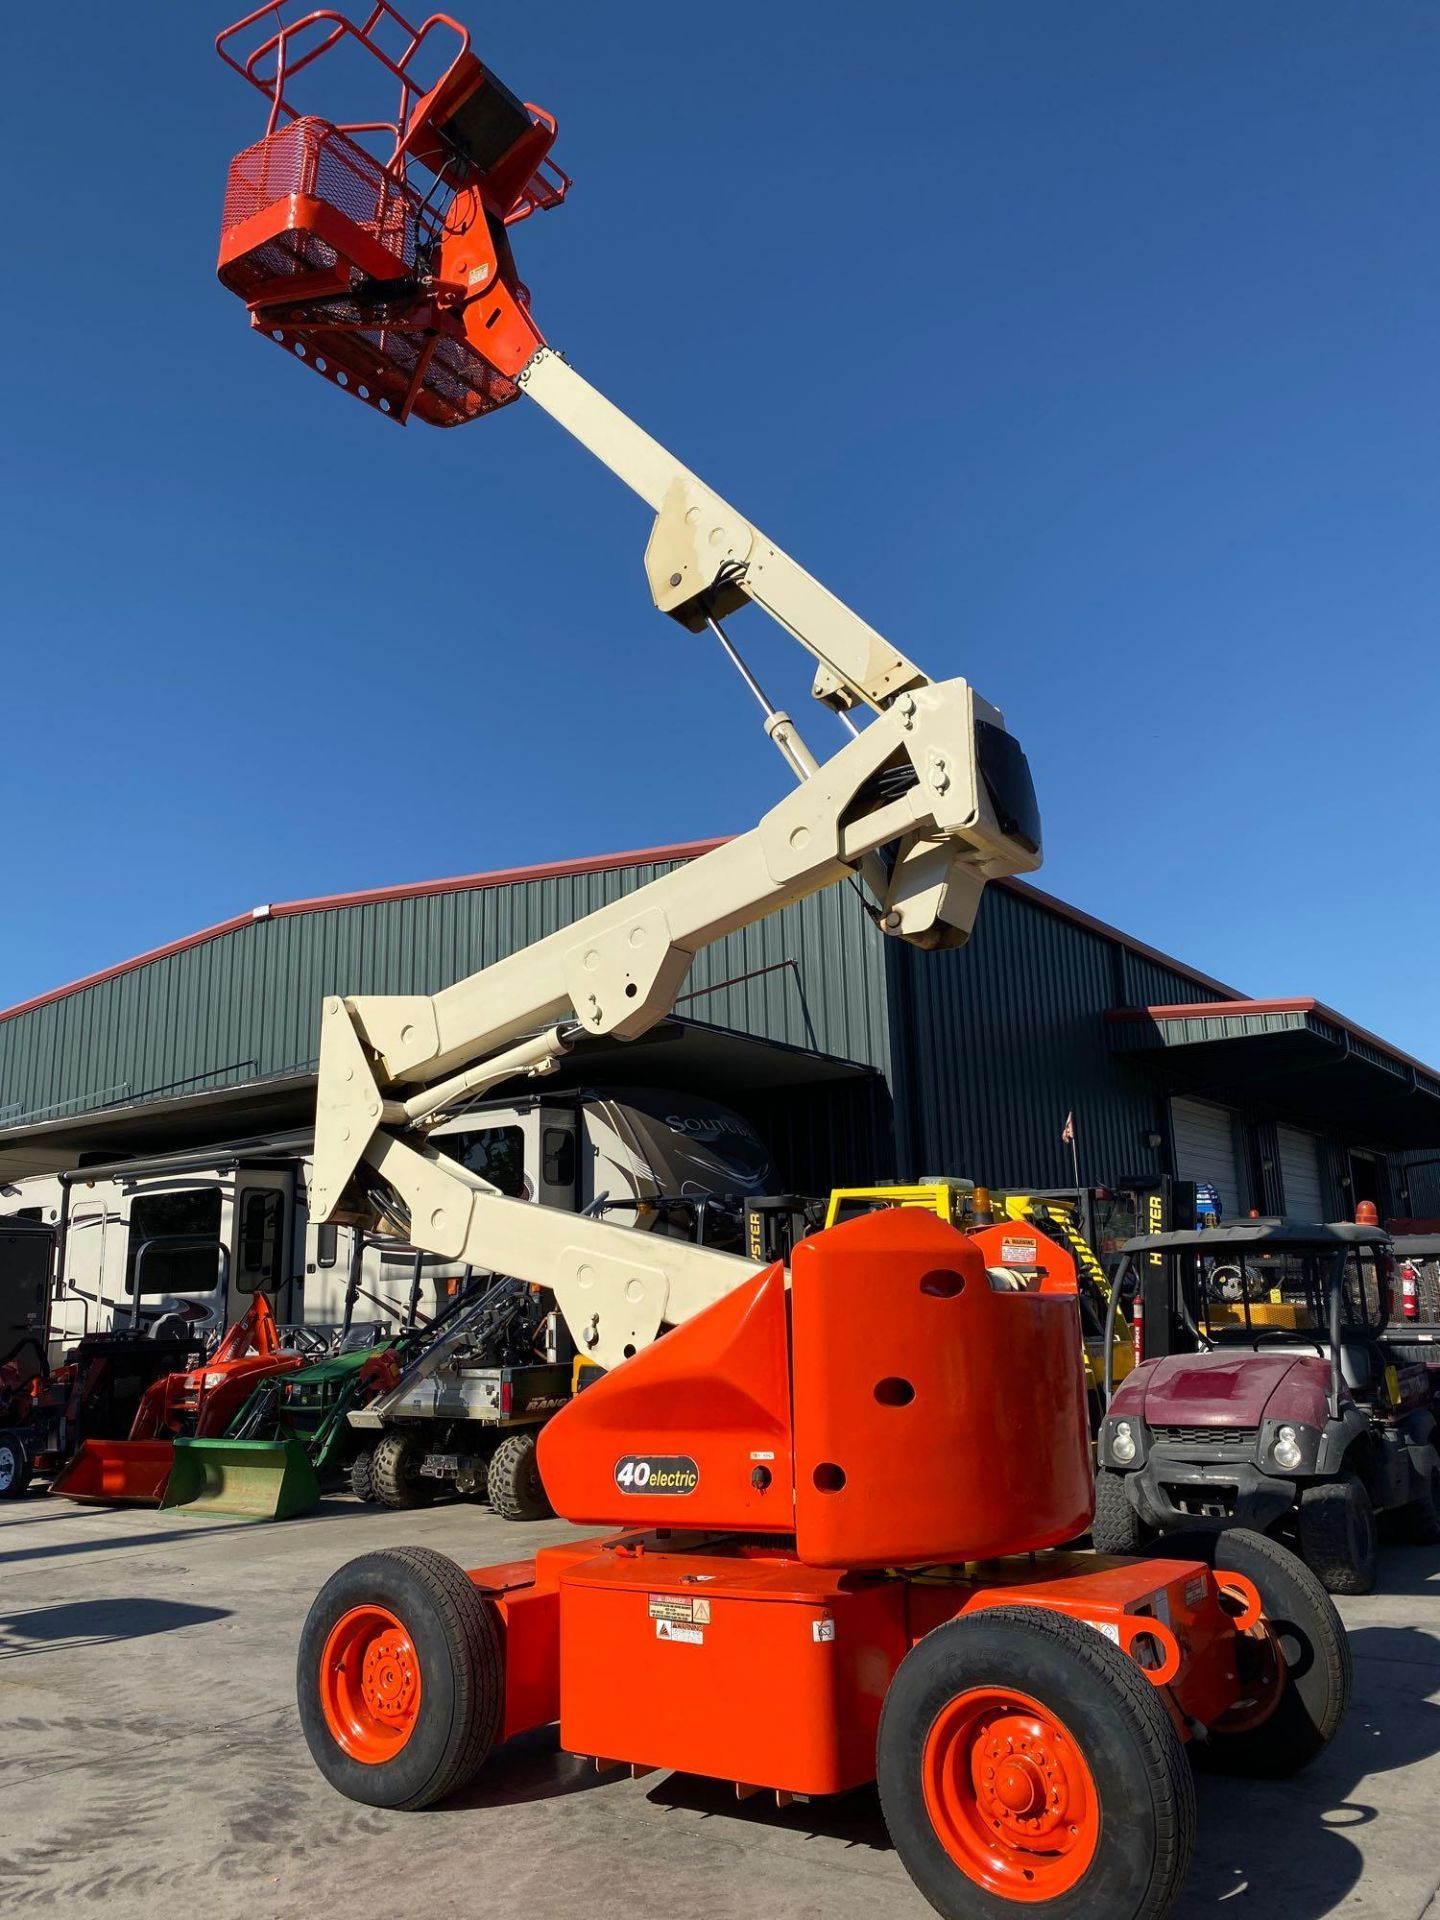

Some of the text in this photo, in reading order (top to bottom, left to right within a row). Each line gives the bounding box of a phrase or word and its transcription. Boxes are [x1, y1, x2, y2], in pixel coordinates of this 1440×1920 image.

[1011, 1238, 1035, 1246] WARNING
[1149, 1196, 1162, 1265] HTER
[617, 1462, 696, 1487] 40 electric
